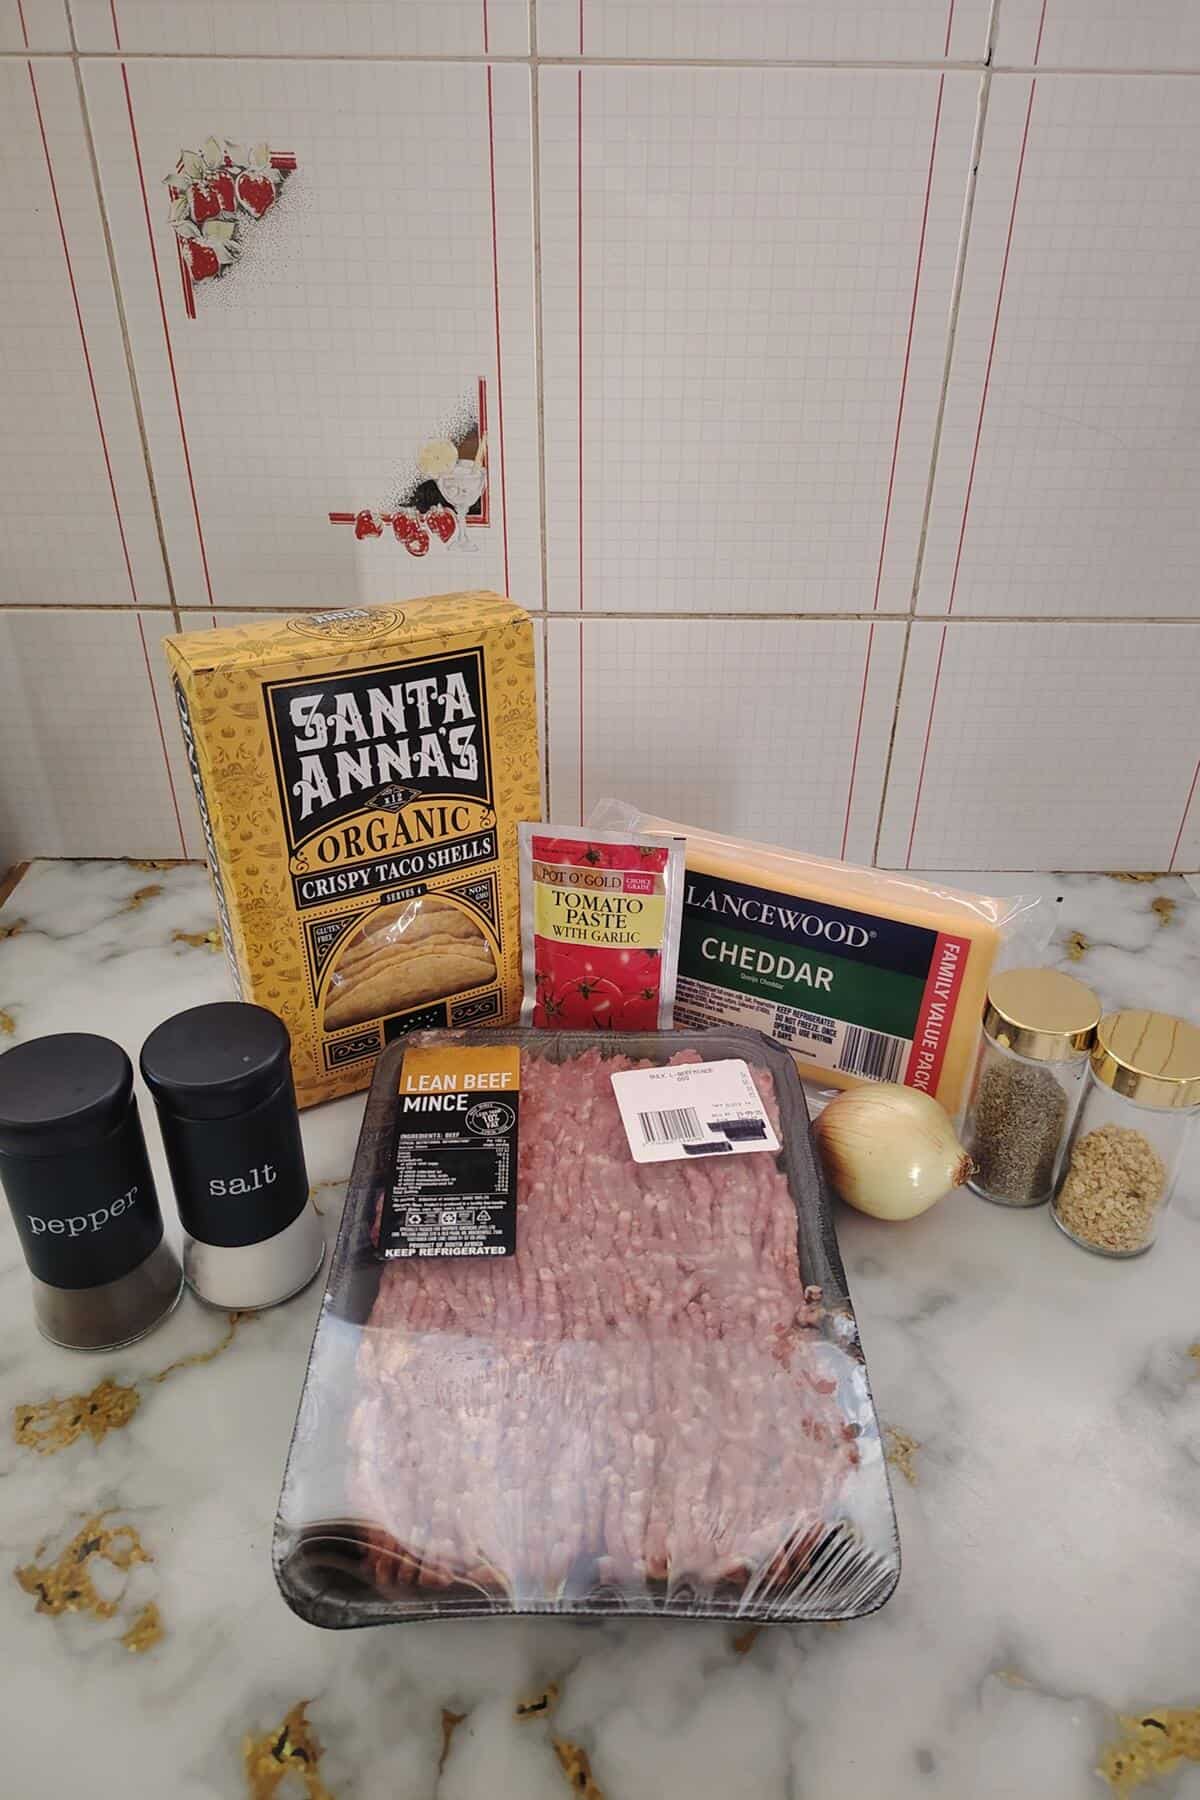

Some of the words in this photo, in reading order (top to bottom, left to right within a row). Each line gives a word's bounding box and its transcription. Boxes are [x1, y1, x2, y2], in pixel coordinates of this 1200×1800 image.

[289, 671, 477, 752] SANTA
[292, 724, 480, 821] ANNA'S
[317, 806, 471, 863] ORGANIC
[302, 868, 375, 899] CRISPY
[375, 855, 424, 882] TACO
[427, 837, 491, 869] SHELLS
[542, 868, 567, 882] POT
[468, 885, 488, 895] NON
[552, 890, 644, 914] TOMATO
[552, 925, 587, 940] WITH
[591, 930, 641, 944] GARLIC
[567, 909, 628, 929] PASTE
[686, 885, 870, 948] LANCEWOOD
[701, 937, 835, 992] CHEDDAR
[933, 943, 960, 1000] FAMILY
[921, 1003, 947, 1050] VALUE
[405, 1074, 457, 1092] LEAN
[463, 1072, 513, 1089] BEEF
[912, 1051, 935, 1091] PACK
[403, 1094, 469, 1113] MINCE
[208, 1163, 278, 1197] salt
[27, 1185, 139, 1237] pepper
[385, 1248, 416, 1257] KEEP
[419, 1246, 506, 1257] REFRIGERATED
